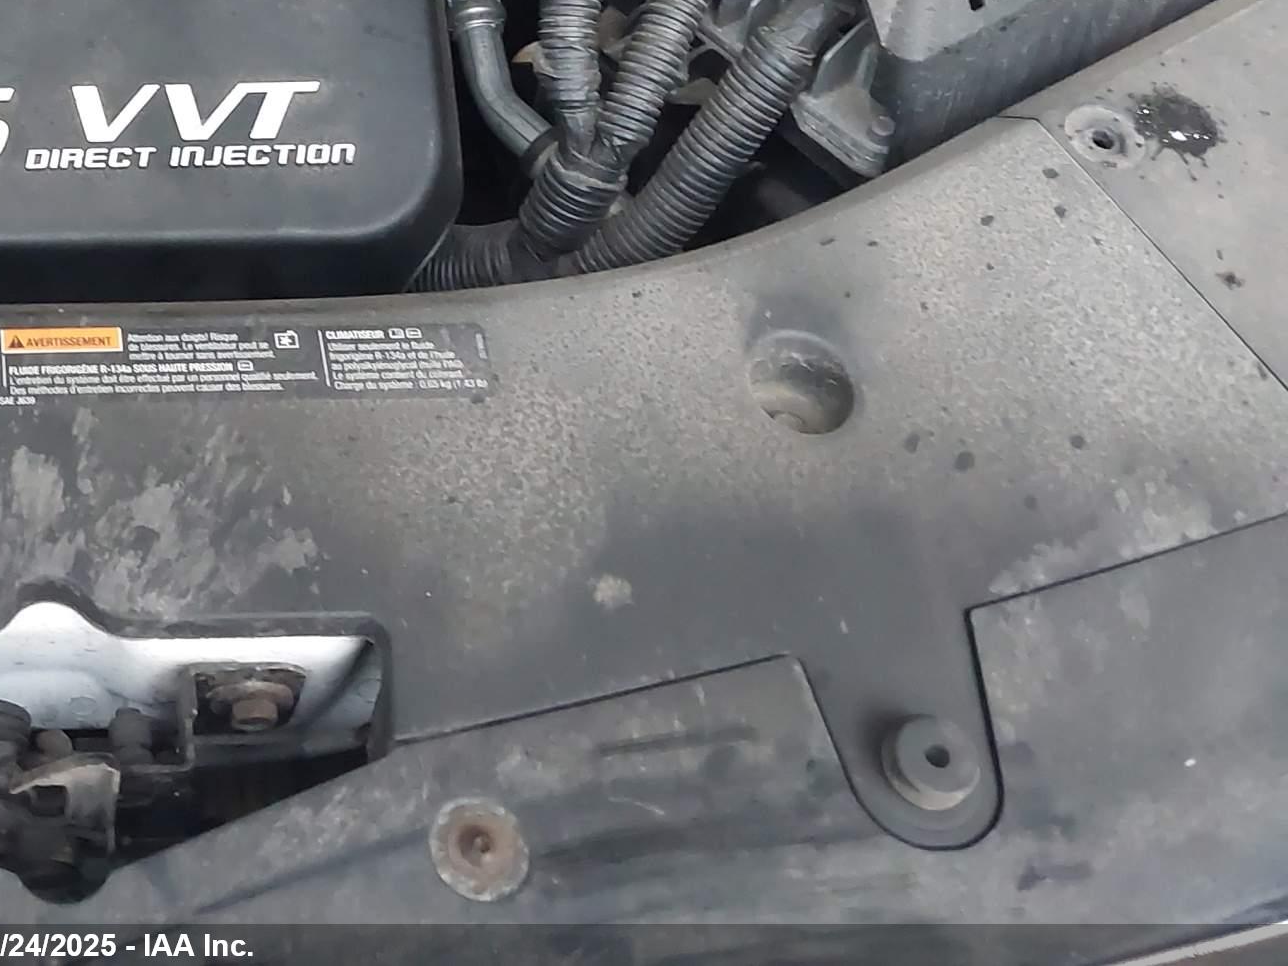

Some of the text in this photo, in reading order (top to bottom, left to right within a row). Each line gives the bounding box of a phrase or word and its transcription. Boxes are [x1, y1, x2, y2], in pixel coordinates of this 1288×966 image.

[71, 80, 321, 143] VVT
[24, 143, 356, 170] DIRECT INJECTION
[325, 329, 385, 340] CLIMATISEUR
[26, 336, 112, 347] AVERTISSEMENT
[9, 365, 40, 375] FLUIDE
[100, 364, 132, 374] R-134a
[133, 363, 158, 374] SOUS
[158, 363, 189, 373] HAUTE
[189, 362, 233, 372] PRESSION
[334, 381, 364, 392] Charge
[0, 396, 14, 405] SAE
